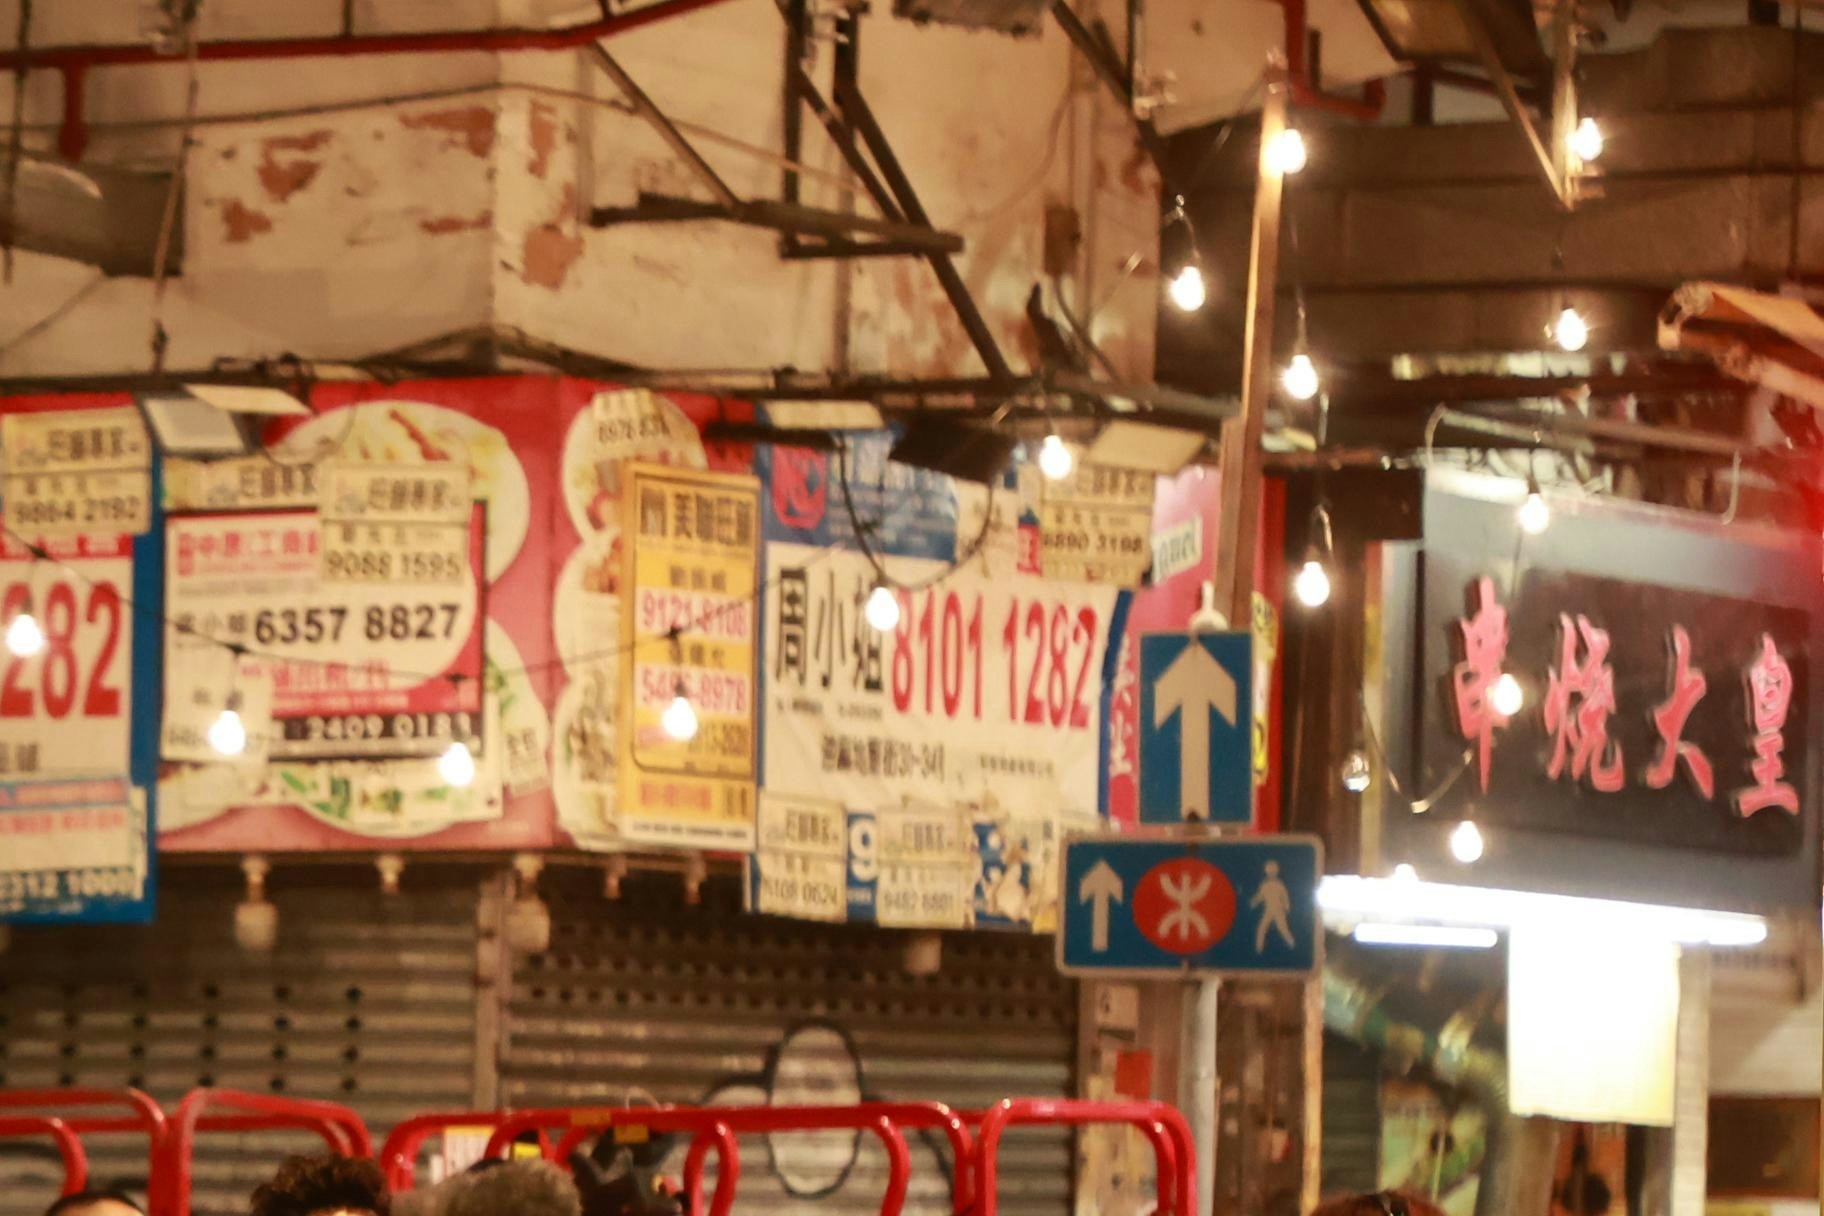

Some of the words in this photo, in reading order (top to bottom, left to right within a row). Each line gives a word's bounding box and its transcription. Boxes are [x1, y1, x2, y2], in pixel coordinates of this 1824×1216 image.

[254, 606, 349, 645] 6357
[364, 602, 462, 643] 8827
[891, 582, 983, 722] 8101
[1003, 596, 1098, 729] 1282
